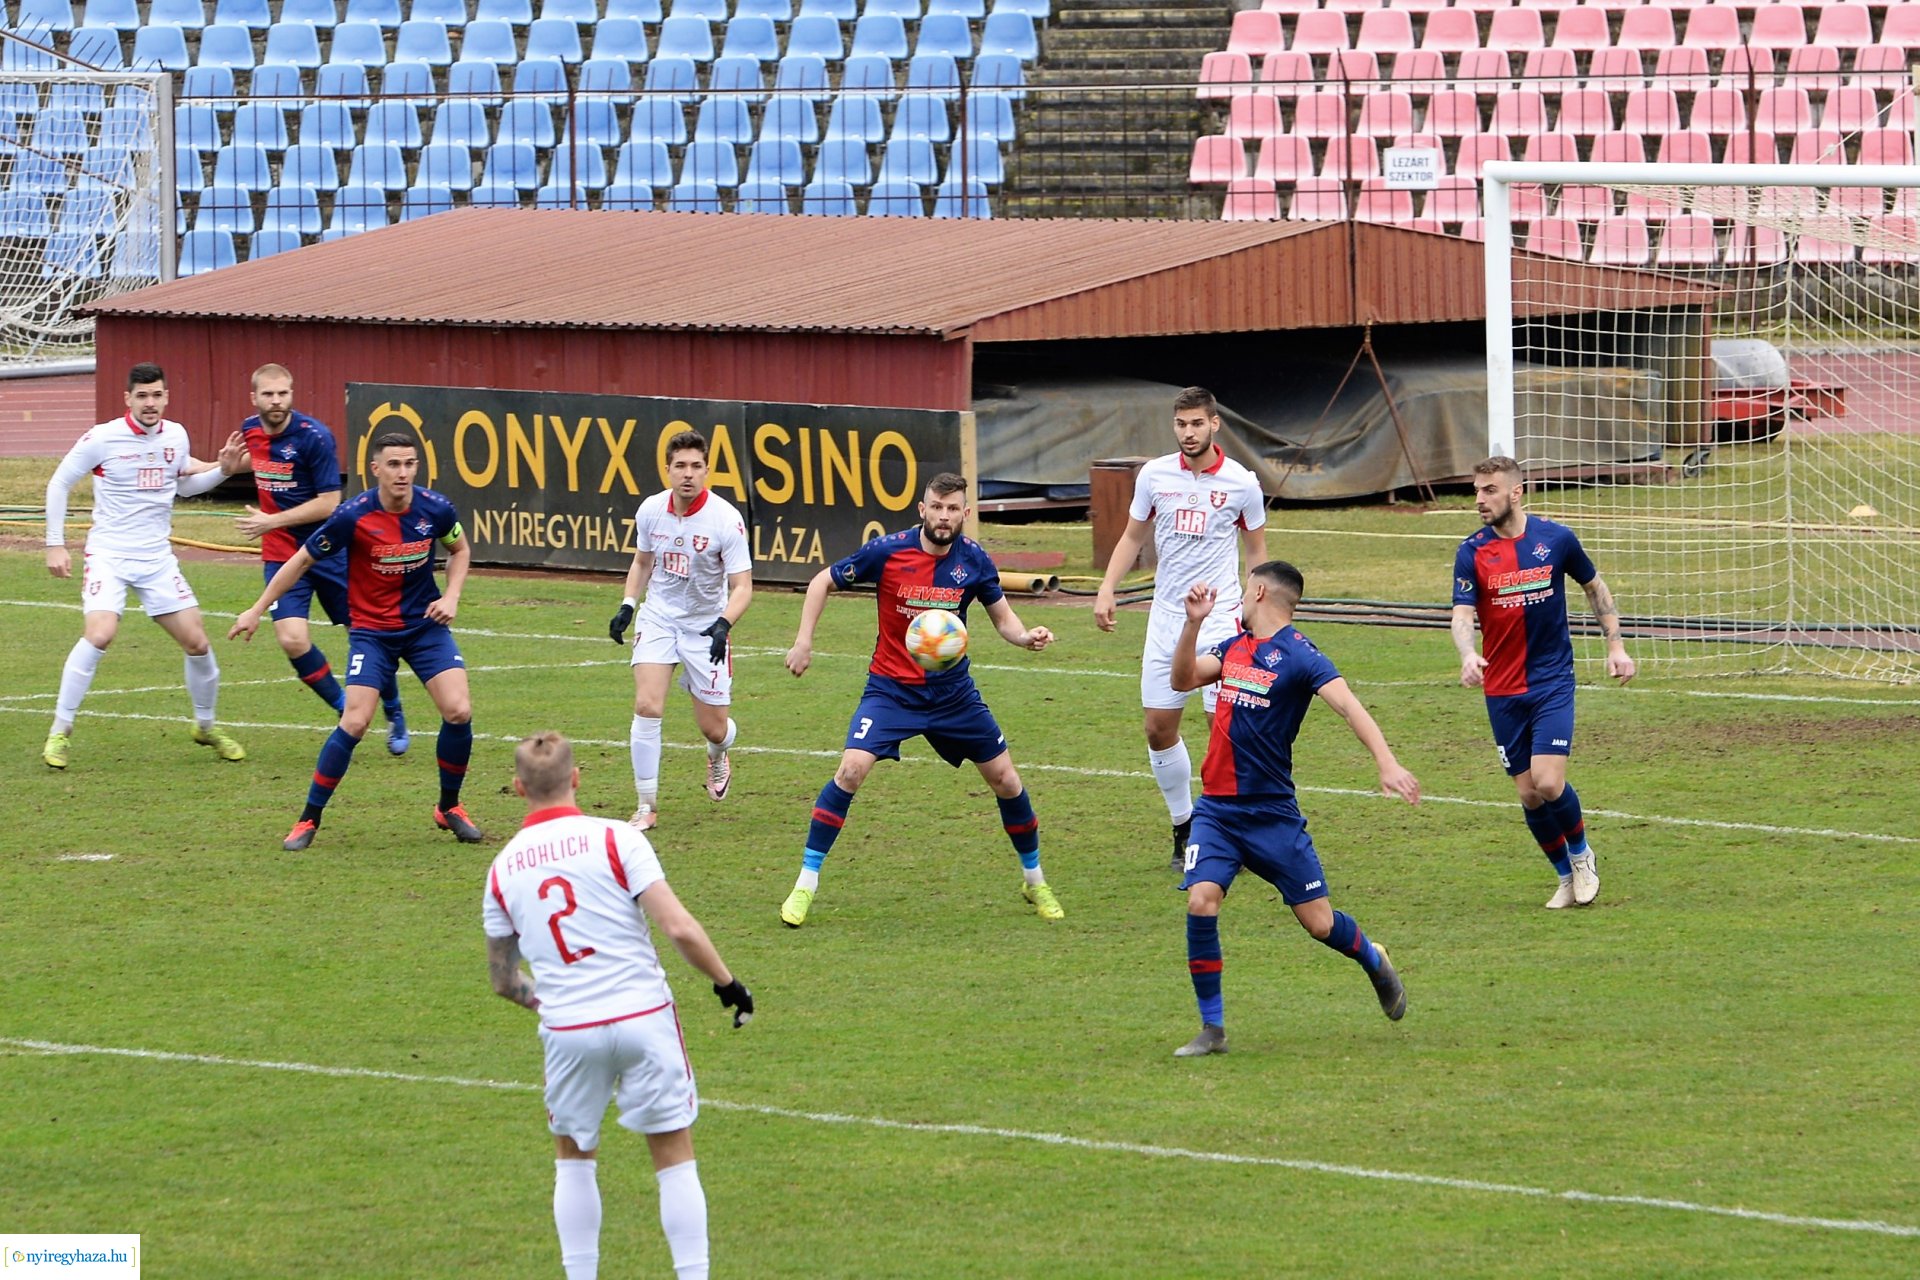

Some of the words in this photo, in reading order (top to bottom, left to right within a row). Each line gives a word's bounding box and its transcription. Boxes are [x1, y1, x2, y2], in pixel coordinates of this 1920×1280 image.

[1389, 171, 1433, 181] SZEKTOR
[454, 409, 640, 495] ONYX
[1176, 509, 1206, 533] HR
[473, 503, 637, 554] NYÍREGYHÁZ
[744, 516, 825, 564] LÁZA
[370, 538, 433, 557] REVESZ
[664, 552, 690, 576] HR
[1488, 565, 1553, 590] REVESZ
[897, 584, 965, 603] REVESZ
[350, 654, 365, 676] 5
[710, 670, 718, 689] 7
[854, 717, 873, 739] 3
[1551, 738, 1568, 747] JAKO
[1305, 879, 1322, 891] JAKO
[538, 875, 596, 965] 2
